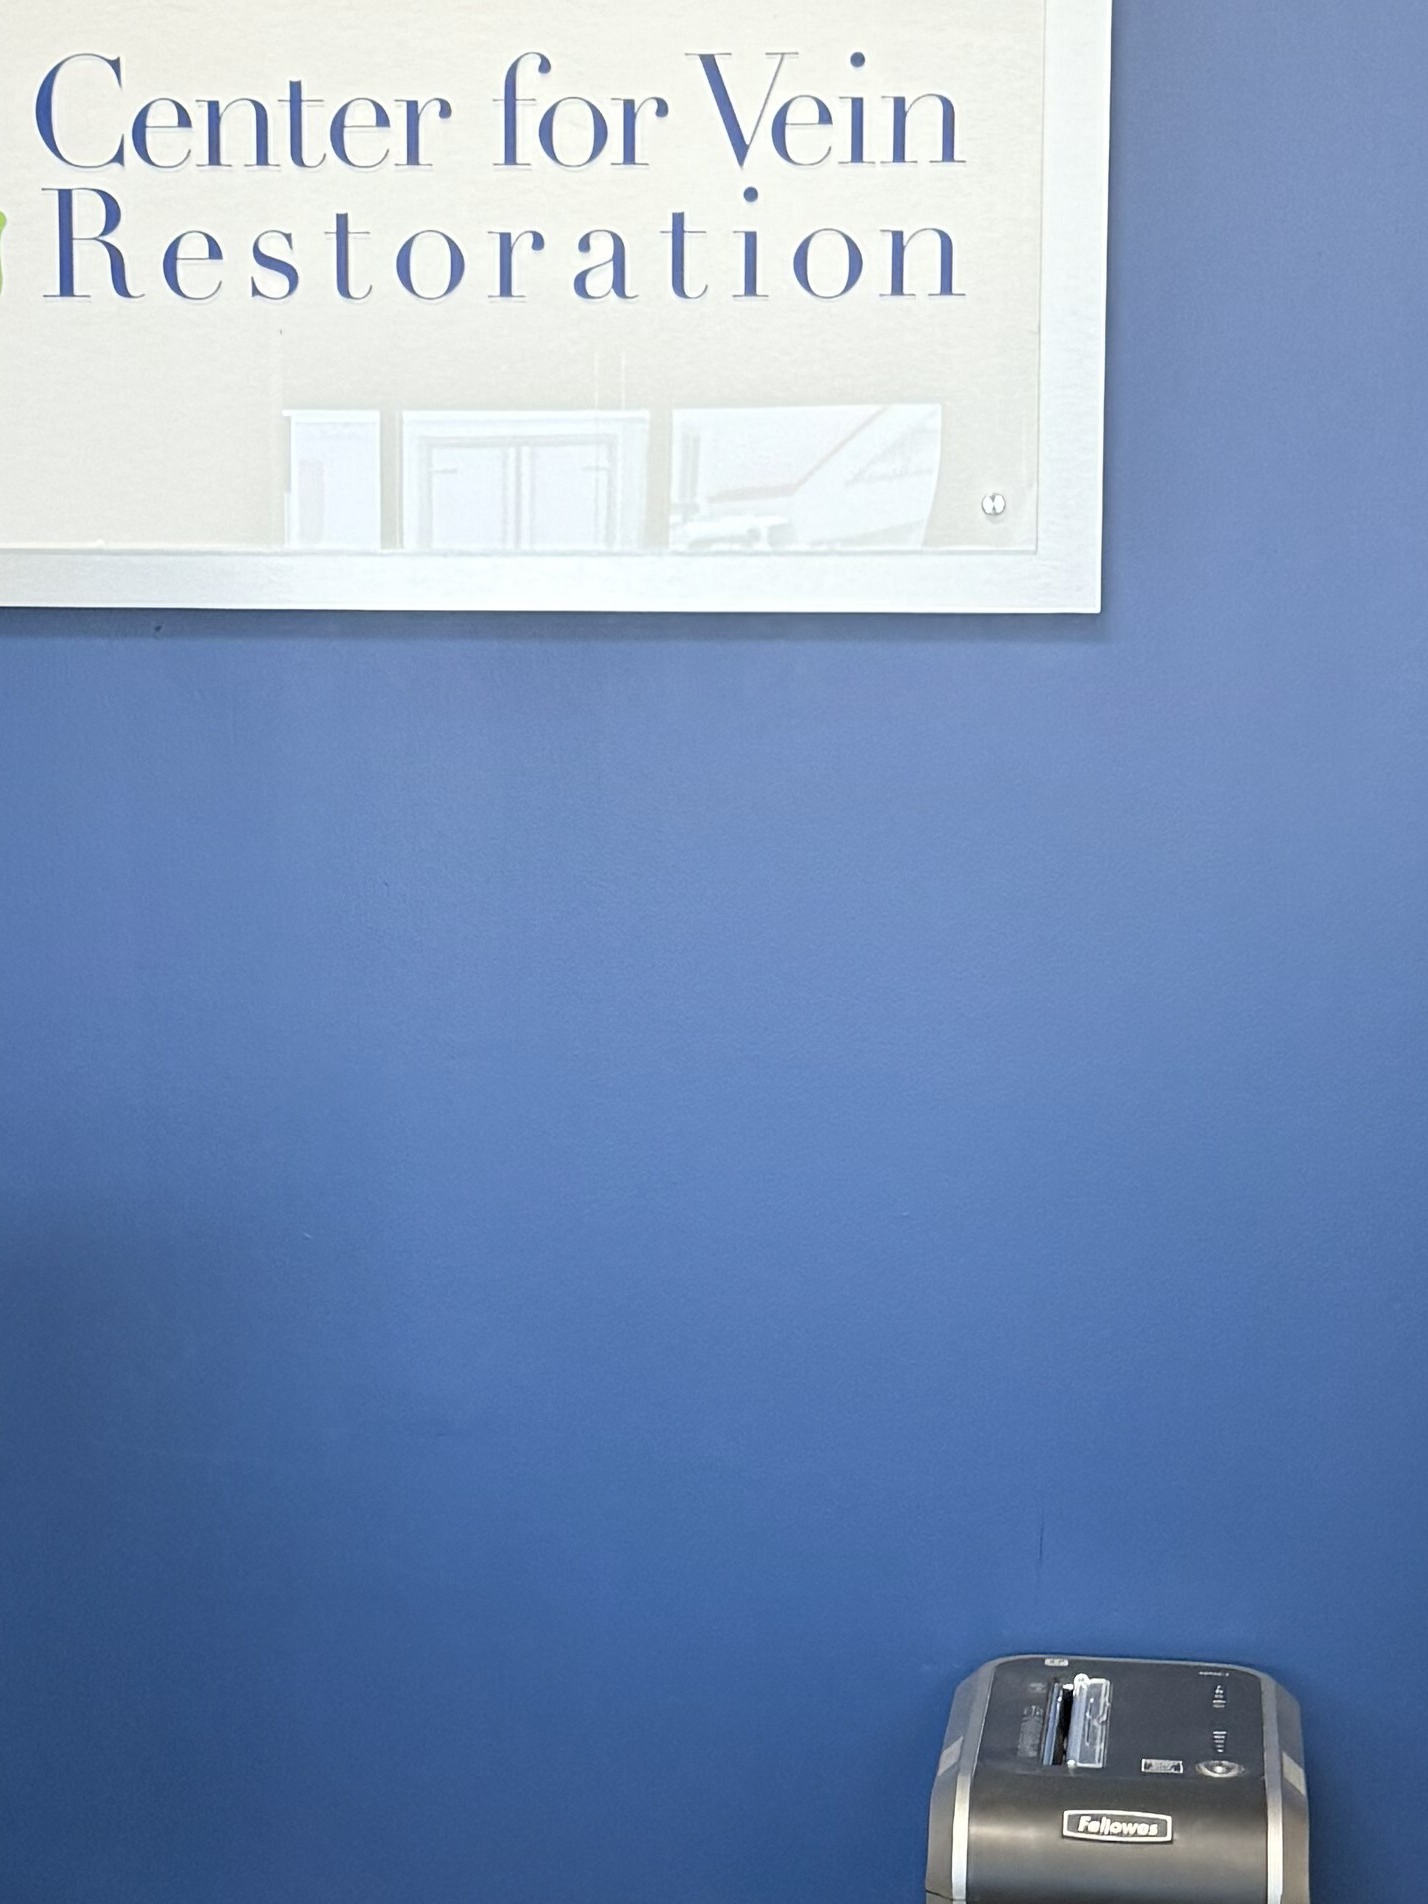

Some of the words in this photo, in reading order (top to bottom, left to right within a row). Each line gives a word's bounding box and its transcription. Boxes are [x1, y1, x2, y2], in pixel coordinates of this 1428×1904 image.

[33, 52, 453, 169] Center
[492, 50, 670, 167] for
[684, 50, 967, 167] Vein
[42, 186, 967, 300] Restoration
[1077, 1815, 1159, 1836] Fellowes
